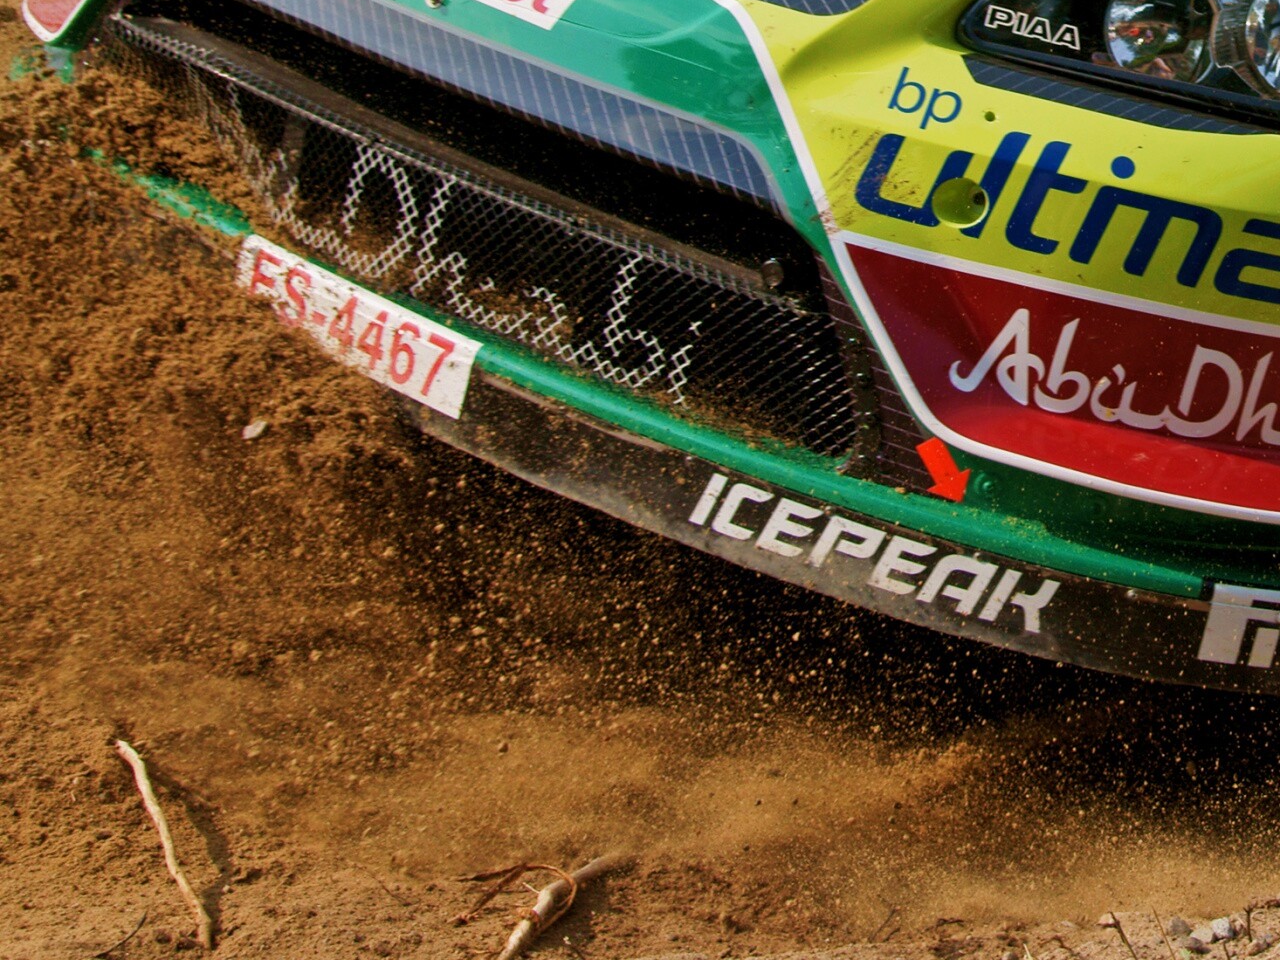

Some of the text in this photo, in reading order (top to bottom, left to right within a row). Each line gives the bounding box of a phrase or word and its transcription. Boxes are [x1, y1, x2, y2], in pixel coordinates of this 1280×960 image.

[984, 4, 1081, 51] PIAA
[888, 66, 963, 130] bp
[949, 308, 1170, 431] Abu
[687, 472, 1061, 634] ICEPEAK
